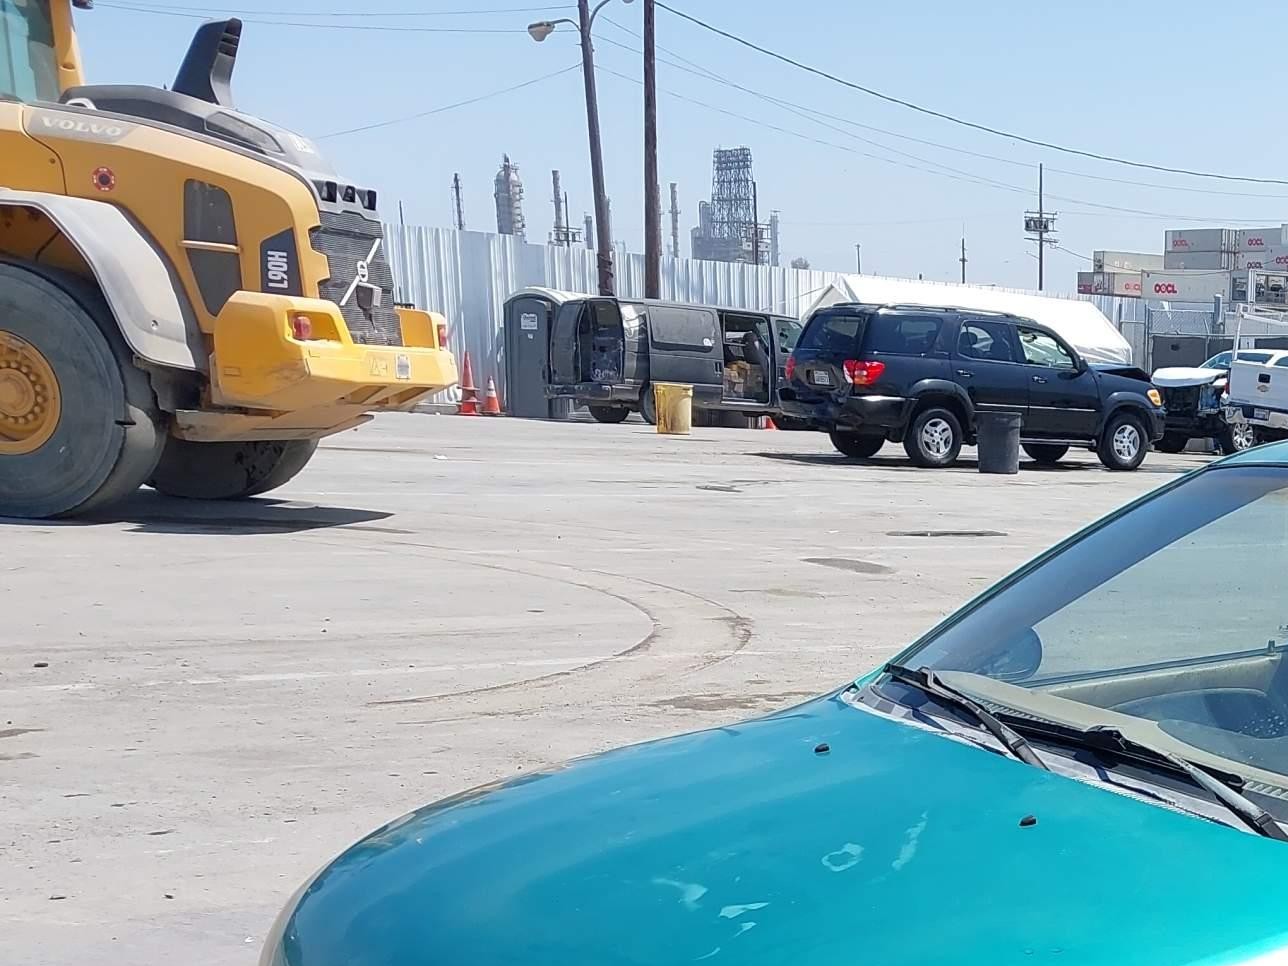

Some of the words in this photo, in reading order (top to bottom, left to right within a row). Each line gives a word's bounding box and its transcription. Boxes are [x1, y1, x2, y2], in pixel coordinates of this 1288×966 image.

[41, 117, 121, 137] VOLVO
[1247, 238, 1264, 246] OOCL
[267, 250, 289, 289] L90H
[1247, 261, 1264, 269] OOCL
[1154, 283, 1178, 294] OOCL
